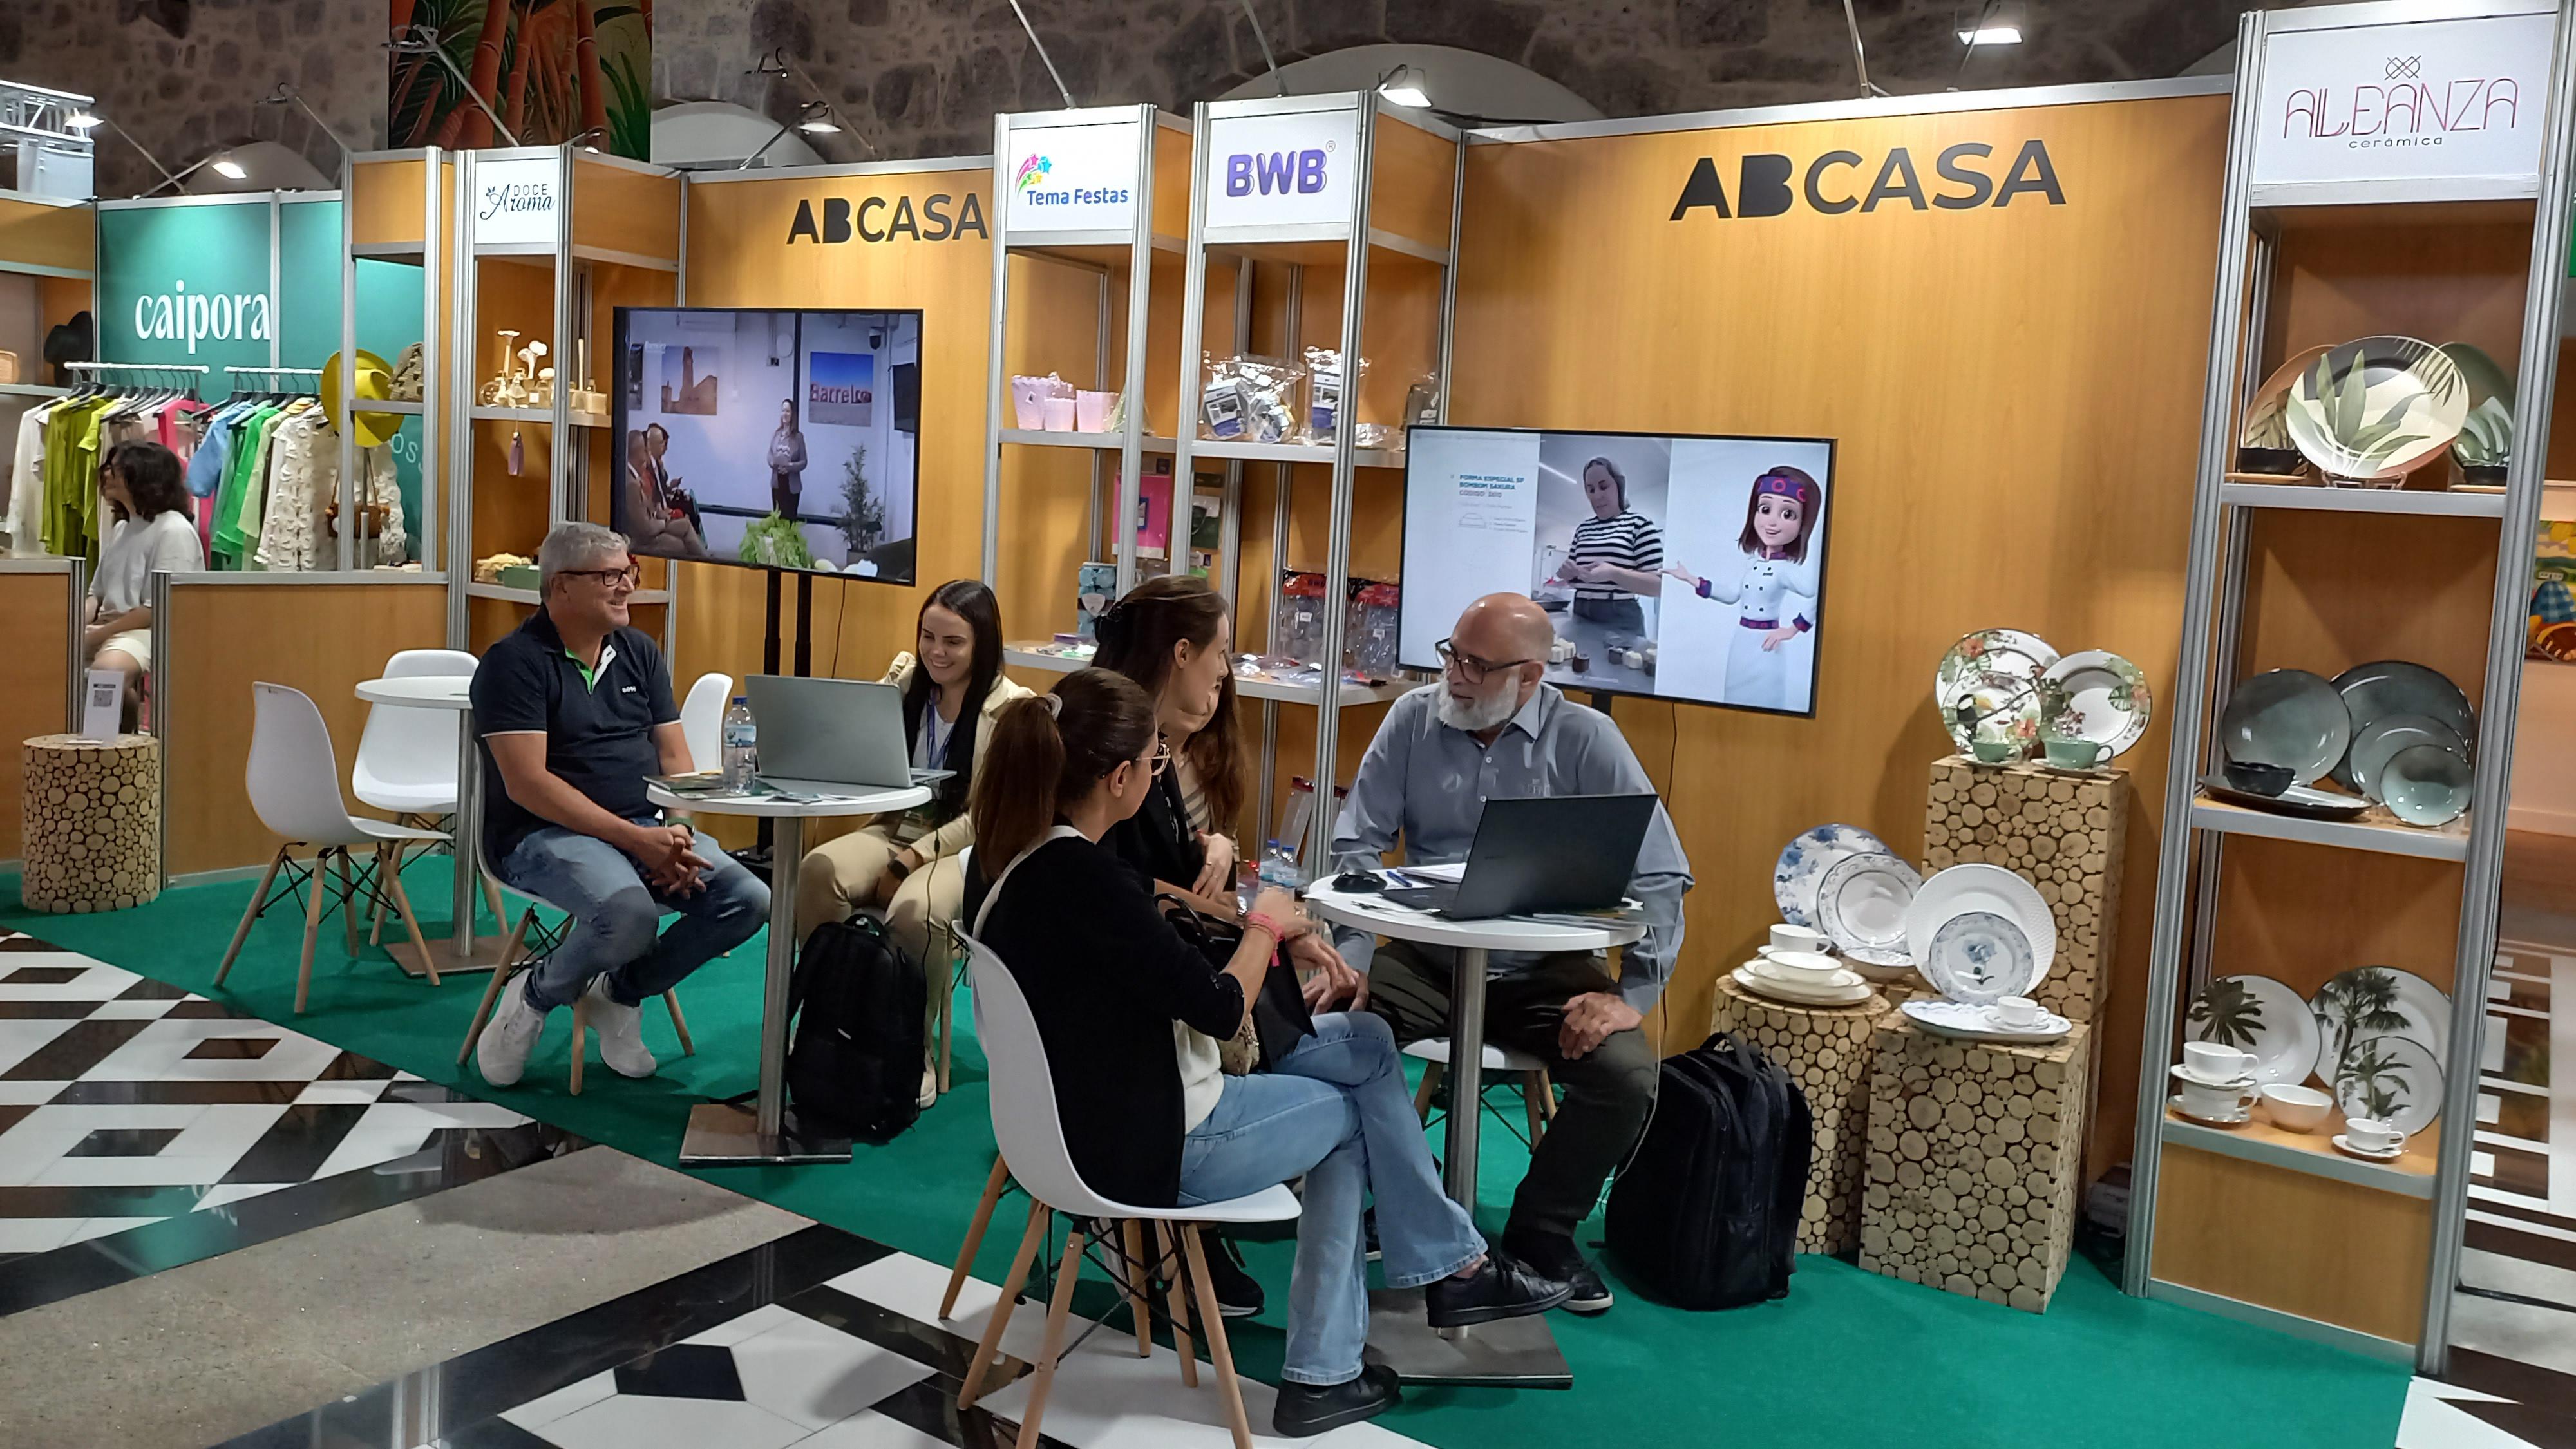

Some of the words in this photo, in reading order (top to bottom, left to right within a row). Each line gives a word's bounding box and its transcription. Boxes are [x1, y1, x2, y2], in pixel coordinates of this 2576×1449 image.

[513, 184, 547, 196] DOCE
[1027, 190, 1070, 205] Tema
[1074, 187, 1128, 204] Festas
[1227, 149, 1327, 197] BWB
[1669, 139, 2067, 222] ABCASA
[480, 183, 556, 220] Aroma
[786, 193, 989, 245] ABCASA
[135, 279, 271, 355] caipora
